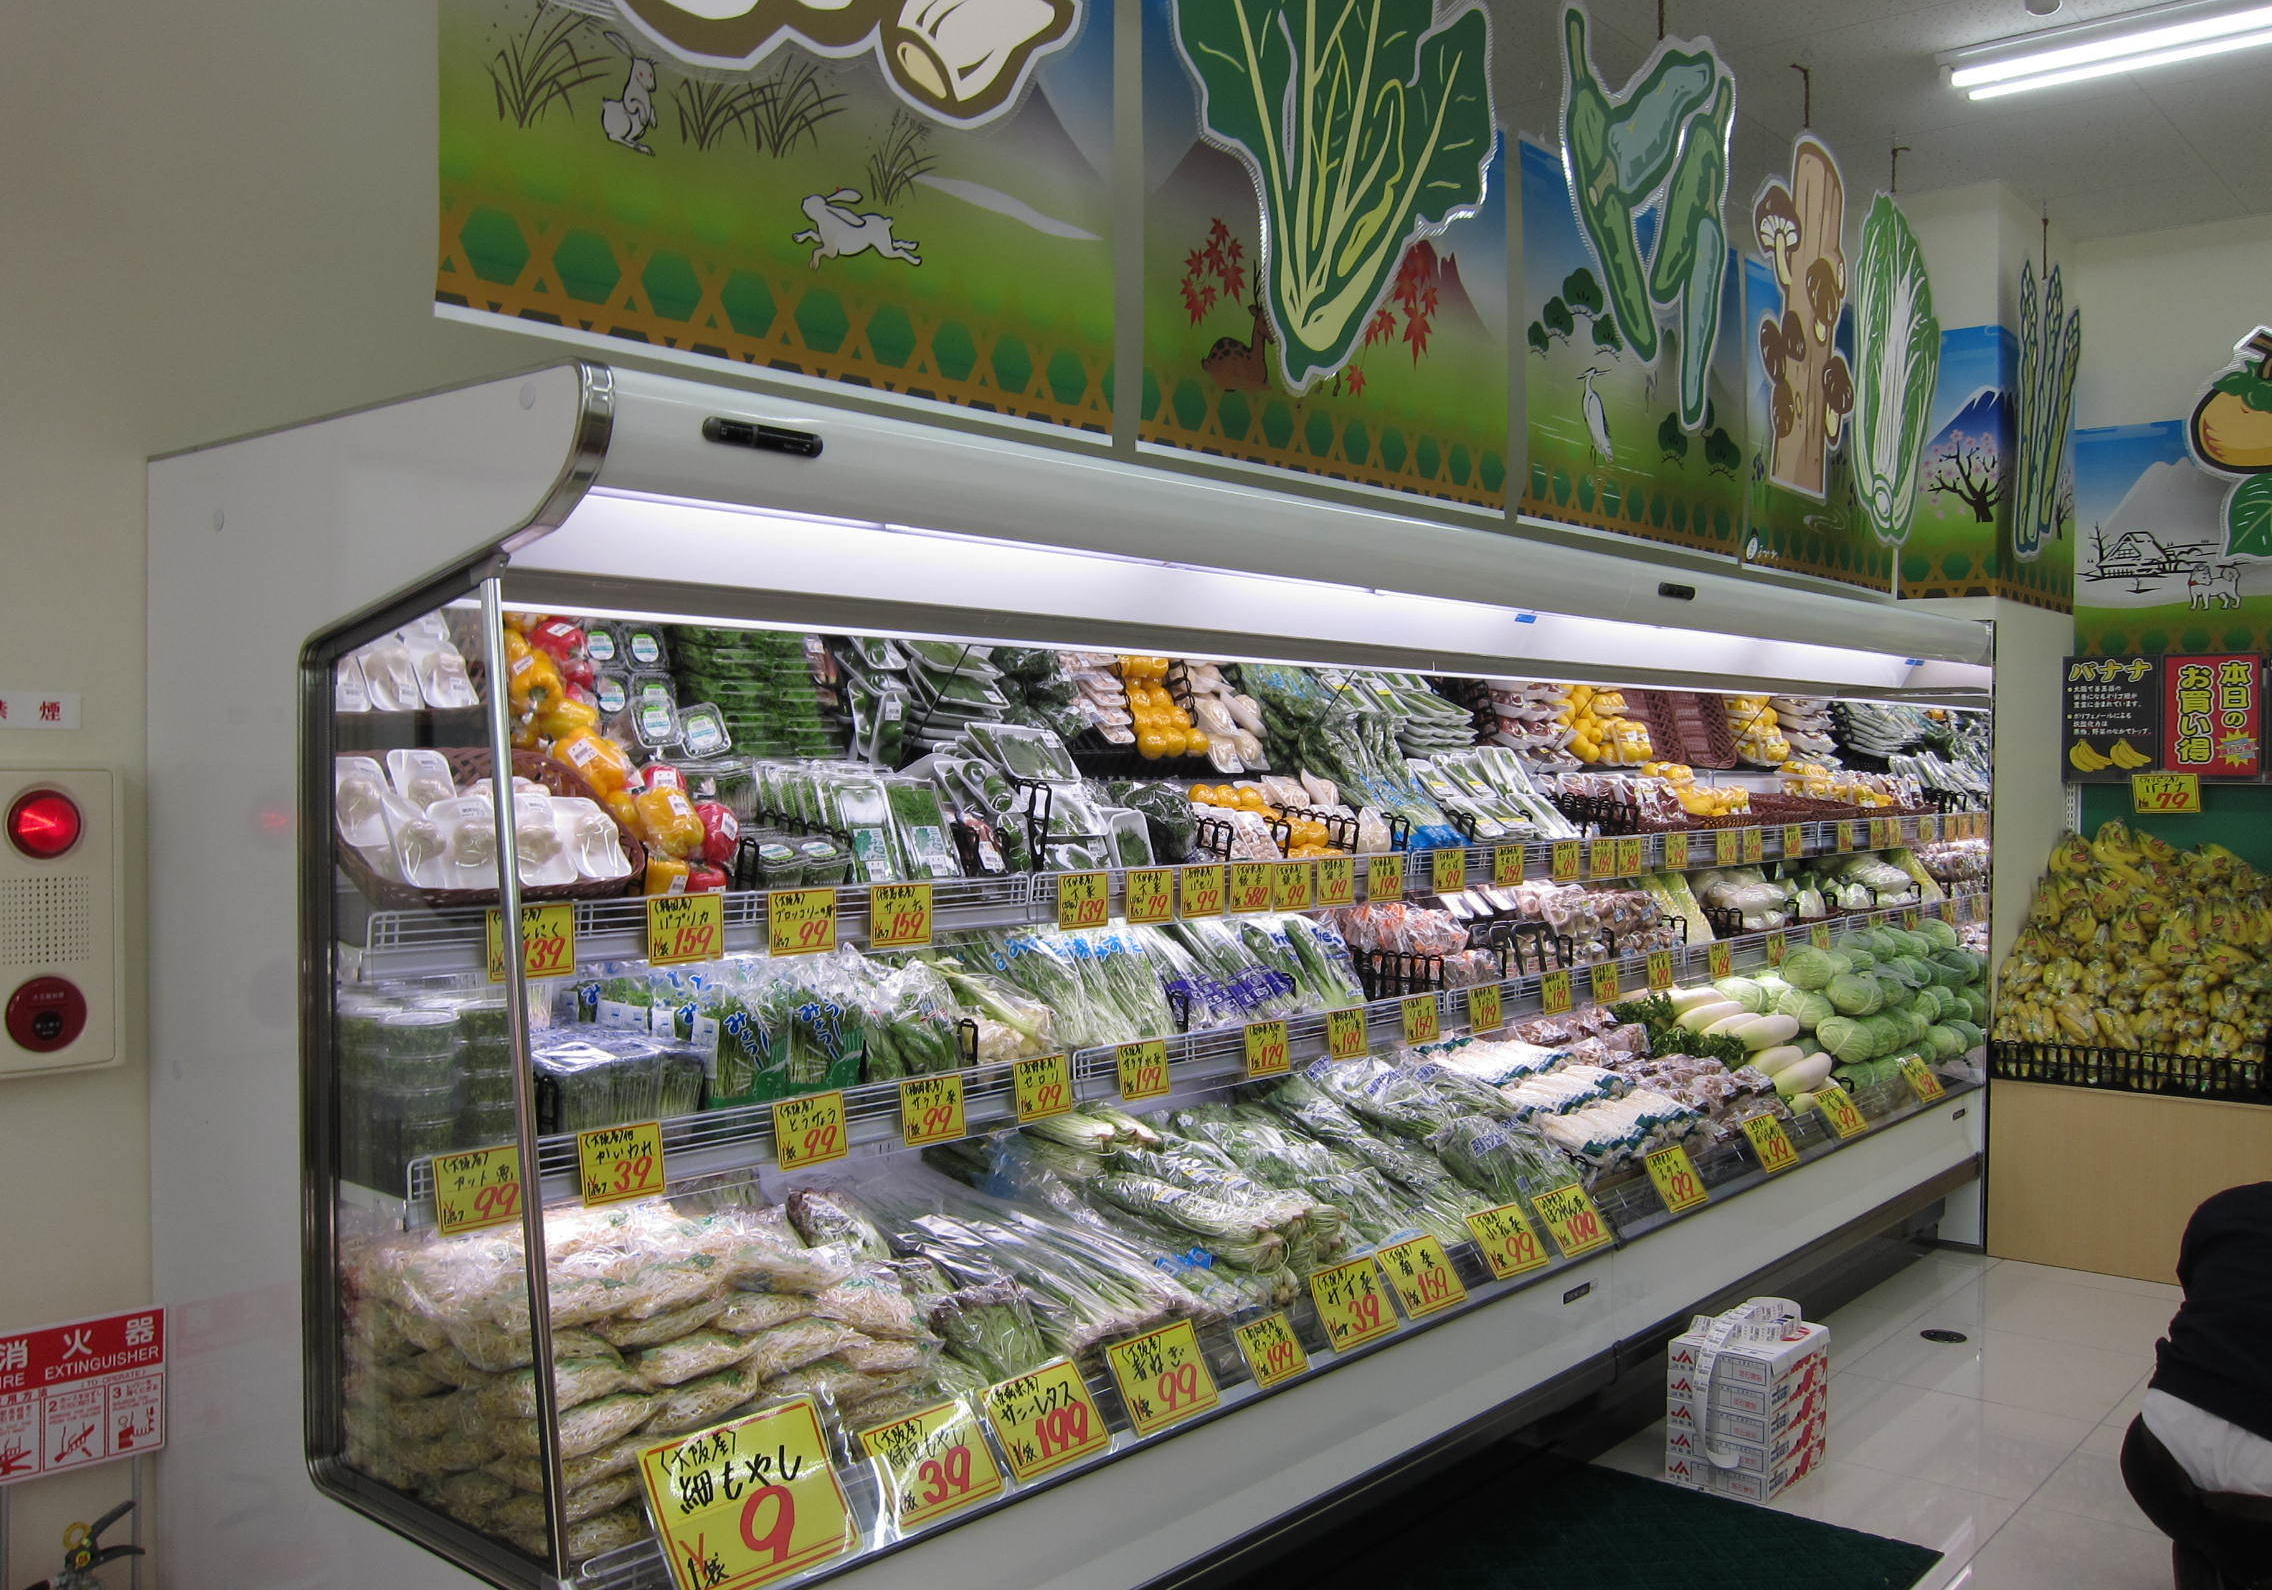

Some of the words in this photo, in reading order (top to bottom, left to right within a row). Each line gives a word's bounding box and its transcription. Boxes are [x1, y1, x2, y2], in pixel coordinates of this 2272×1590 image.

[2068, 658, 2152, 683] バナナ
[2217, 659, 2251, 728] 本日の
[2175, 663, 2214, 765] お買い得
[2146, 782, 2185, 793] バナナ
[2156, 792, 2189, 809] 79
[1197, 890, 1218, 910] 99
[1287, 884, 1306, 905] 99
[1330, 879, 1347, 899] 99
[1077, 899, 1105, 922] 139
[1148, 894, 1168, 916] 79
[660, 911, 709, 930] パプリカ
[799, 919, 828, 946] 99
[891, 911, 925, 938] 159
[673, 925, 714, 957] 159
[1261, 1043, 1284, 1067] 129
[1342, 1031, 1361, 1054] 199
[1024, 1070, 1059, 1088] セロリ
[1136, 1066, 1161, 1092] 199
[912, 1089, 956, 1110] サラダ菜
[1037, 1083, 1062, 1111] 99
[923, 1105, 953, 1135] 99
[595, 1141, 652, 1165] かいわれ
[804, 1125, 837, 1158] 99
[1769, 1136, 1788, 1161] 99
[614, 1156, 653, 1191] 39
[1671, 1172, 1696, 1201] 99
[474, 1182, 520, 1219] 99
[1567, 1211, 1600, 1245] 199
[1505, 1231, 1536, 1264] 99
[1418, 1266, 1449, 1303] 159
[1349, 1294, 1381, 1332] 39
[0, 1316, 155, 1371] 消火器
[1267, 1340, 1294, 1374] 199
[44, 1345, 160, 1381] EXTINGUISHER
[1131, 1345, 1185, 1381] 青ねぎ
[112, 1387, 121, 1398] 3
[1158, 1363, 1197, 1411] 99
[49, 1401, 58, 1412] 2
[1001, 1381, 1078, 1426] サニーレタス
[1035, 1401, 1088, 1459] 199
[680, 1444, 802, 1515] 細もやし
[918, 1445, 971, 1504] 39
[739, 1485, 796, 1565] 9
